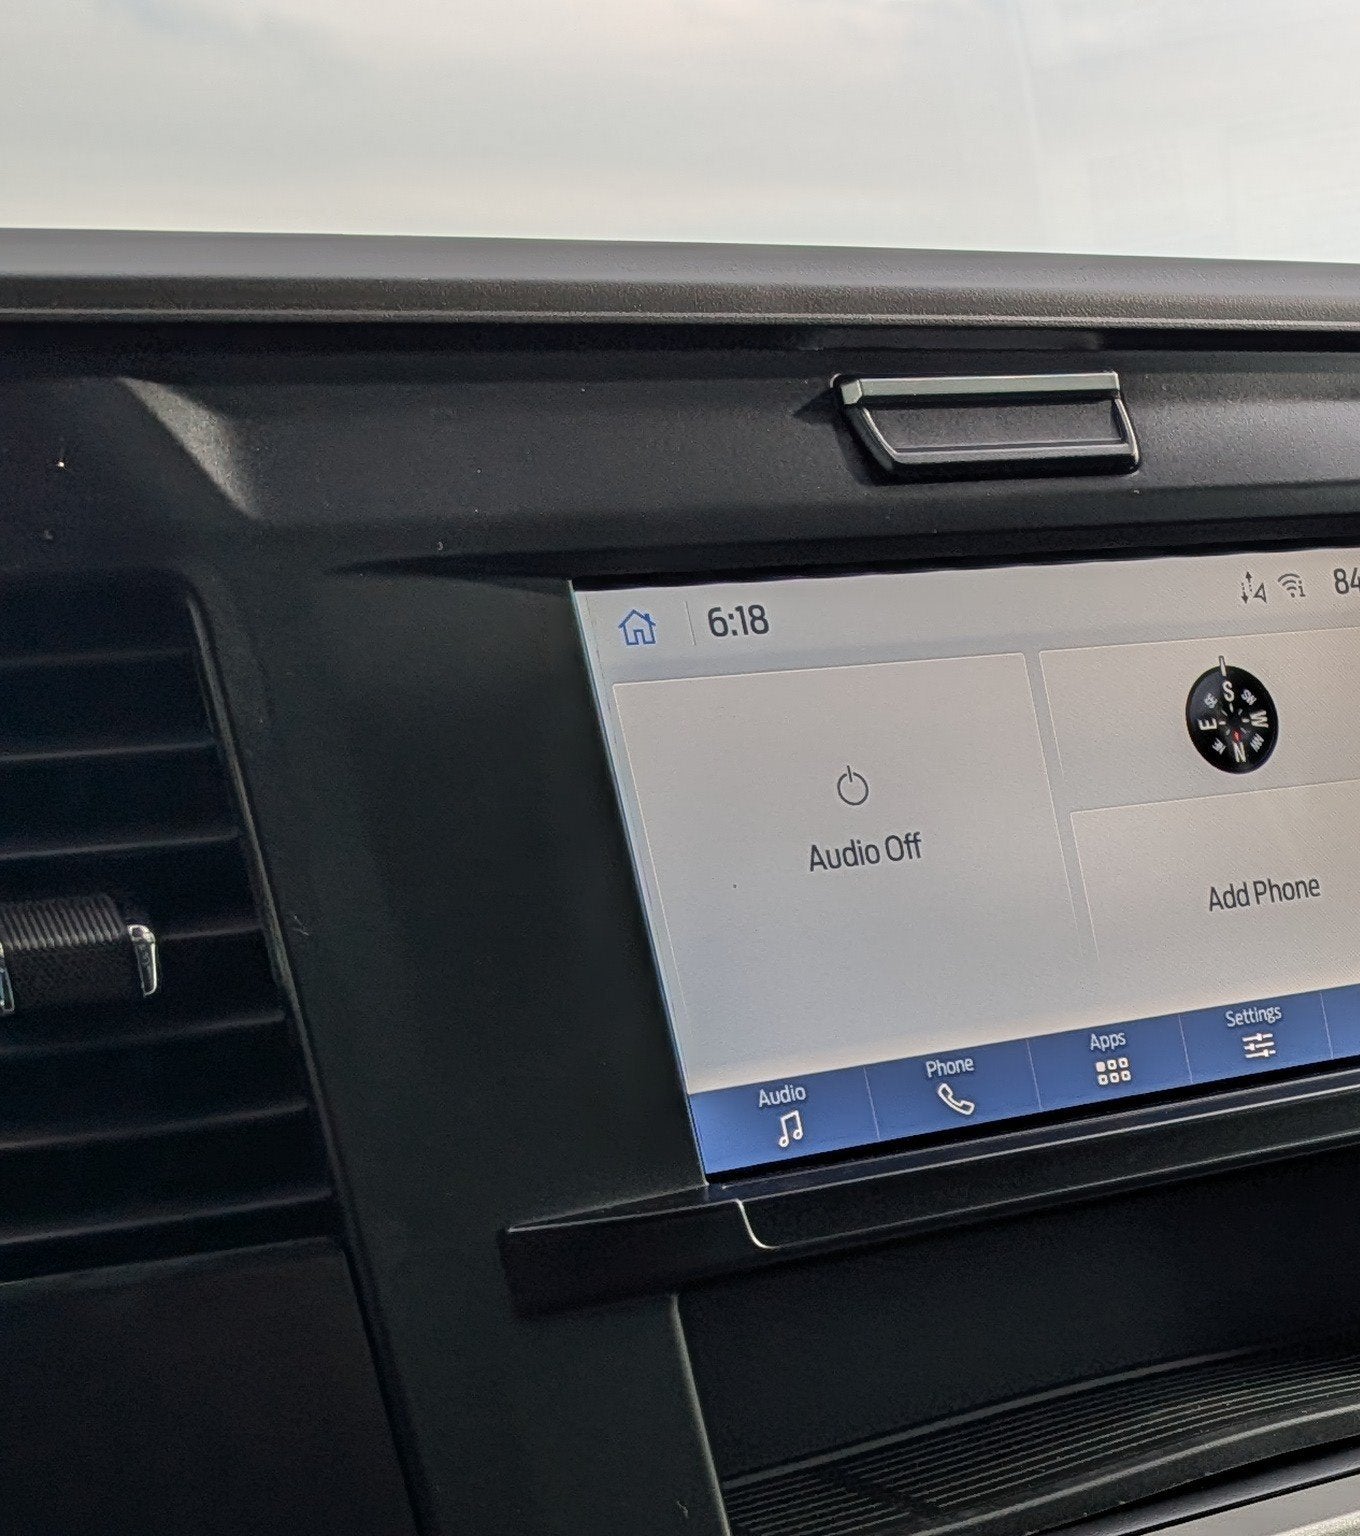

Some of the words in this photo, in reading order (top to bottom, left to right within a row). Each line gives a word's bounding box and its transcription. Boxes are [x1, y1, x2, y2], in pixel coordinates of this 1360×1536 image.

[707, 604, 770, 637] 6:18
[1221, 680, 1235, 702] S
[1198, 717, 1217, 731] E
[1249, 709, 1269, 728] W
[1232, 741, 1247, 763] N
[809, 838, 881, 872] Audio
[884, 831, 922, 862] Off
[1208, 881, 1251, 912] Add
[1253, 876, 1321, 905] Phone
[1224, 1005, 1282, 1028] Settings
[1089, 1031, 1126, 1051] Apps
[925, 1056, 976, 1078] Phone
[758, 1083, 807, 1108] Audio
